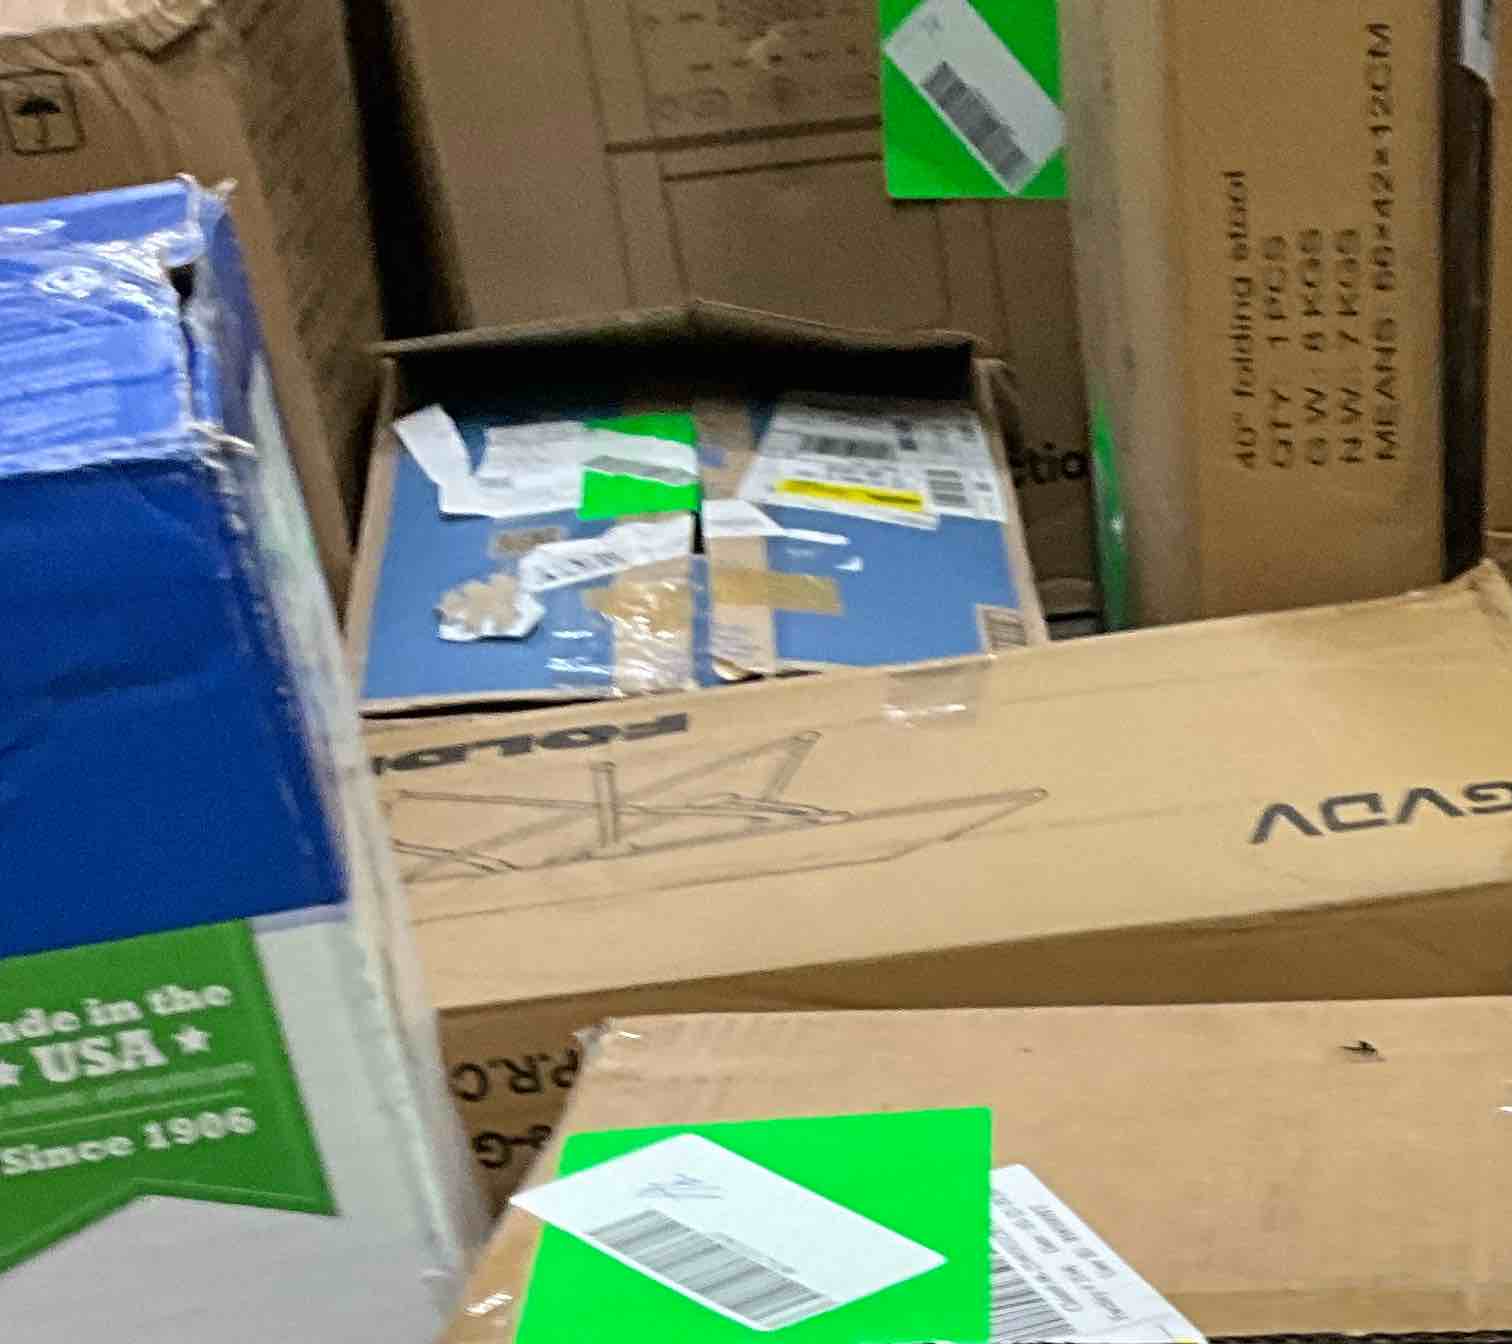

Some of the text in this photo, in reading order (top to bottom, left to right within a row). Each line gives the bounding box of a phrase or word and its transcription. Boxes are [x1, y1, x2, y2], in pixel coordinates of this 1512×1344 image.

[1223, 170, 1250, 262] stool
[1227, 276, 1256, 400] folding
[81, 997, 144, 1026] in
[145, 984, 233, 1016] the
[30, 1029, 169, 1083] USA
[1, 1106, 257, 1176] Since 1906
